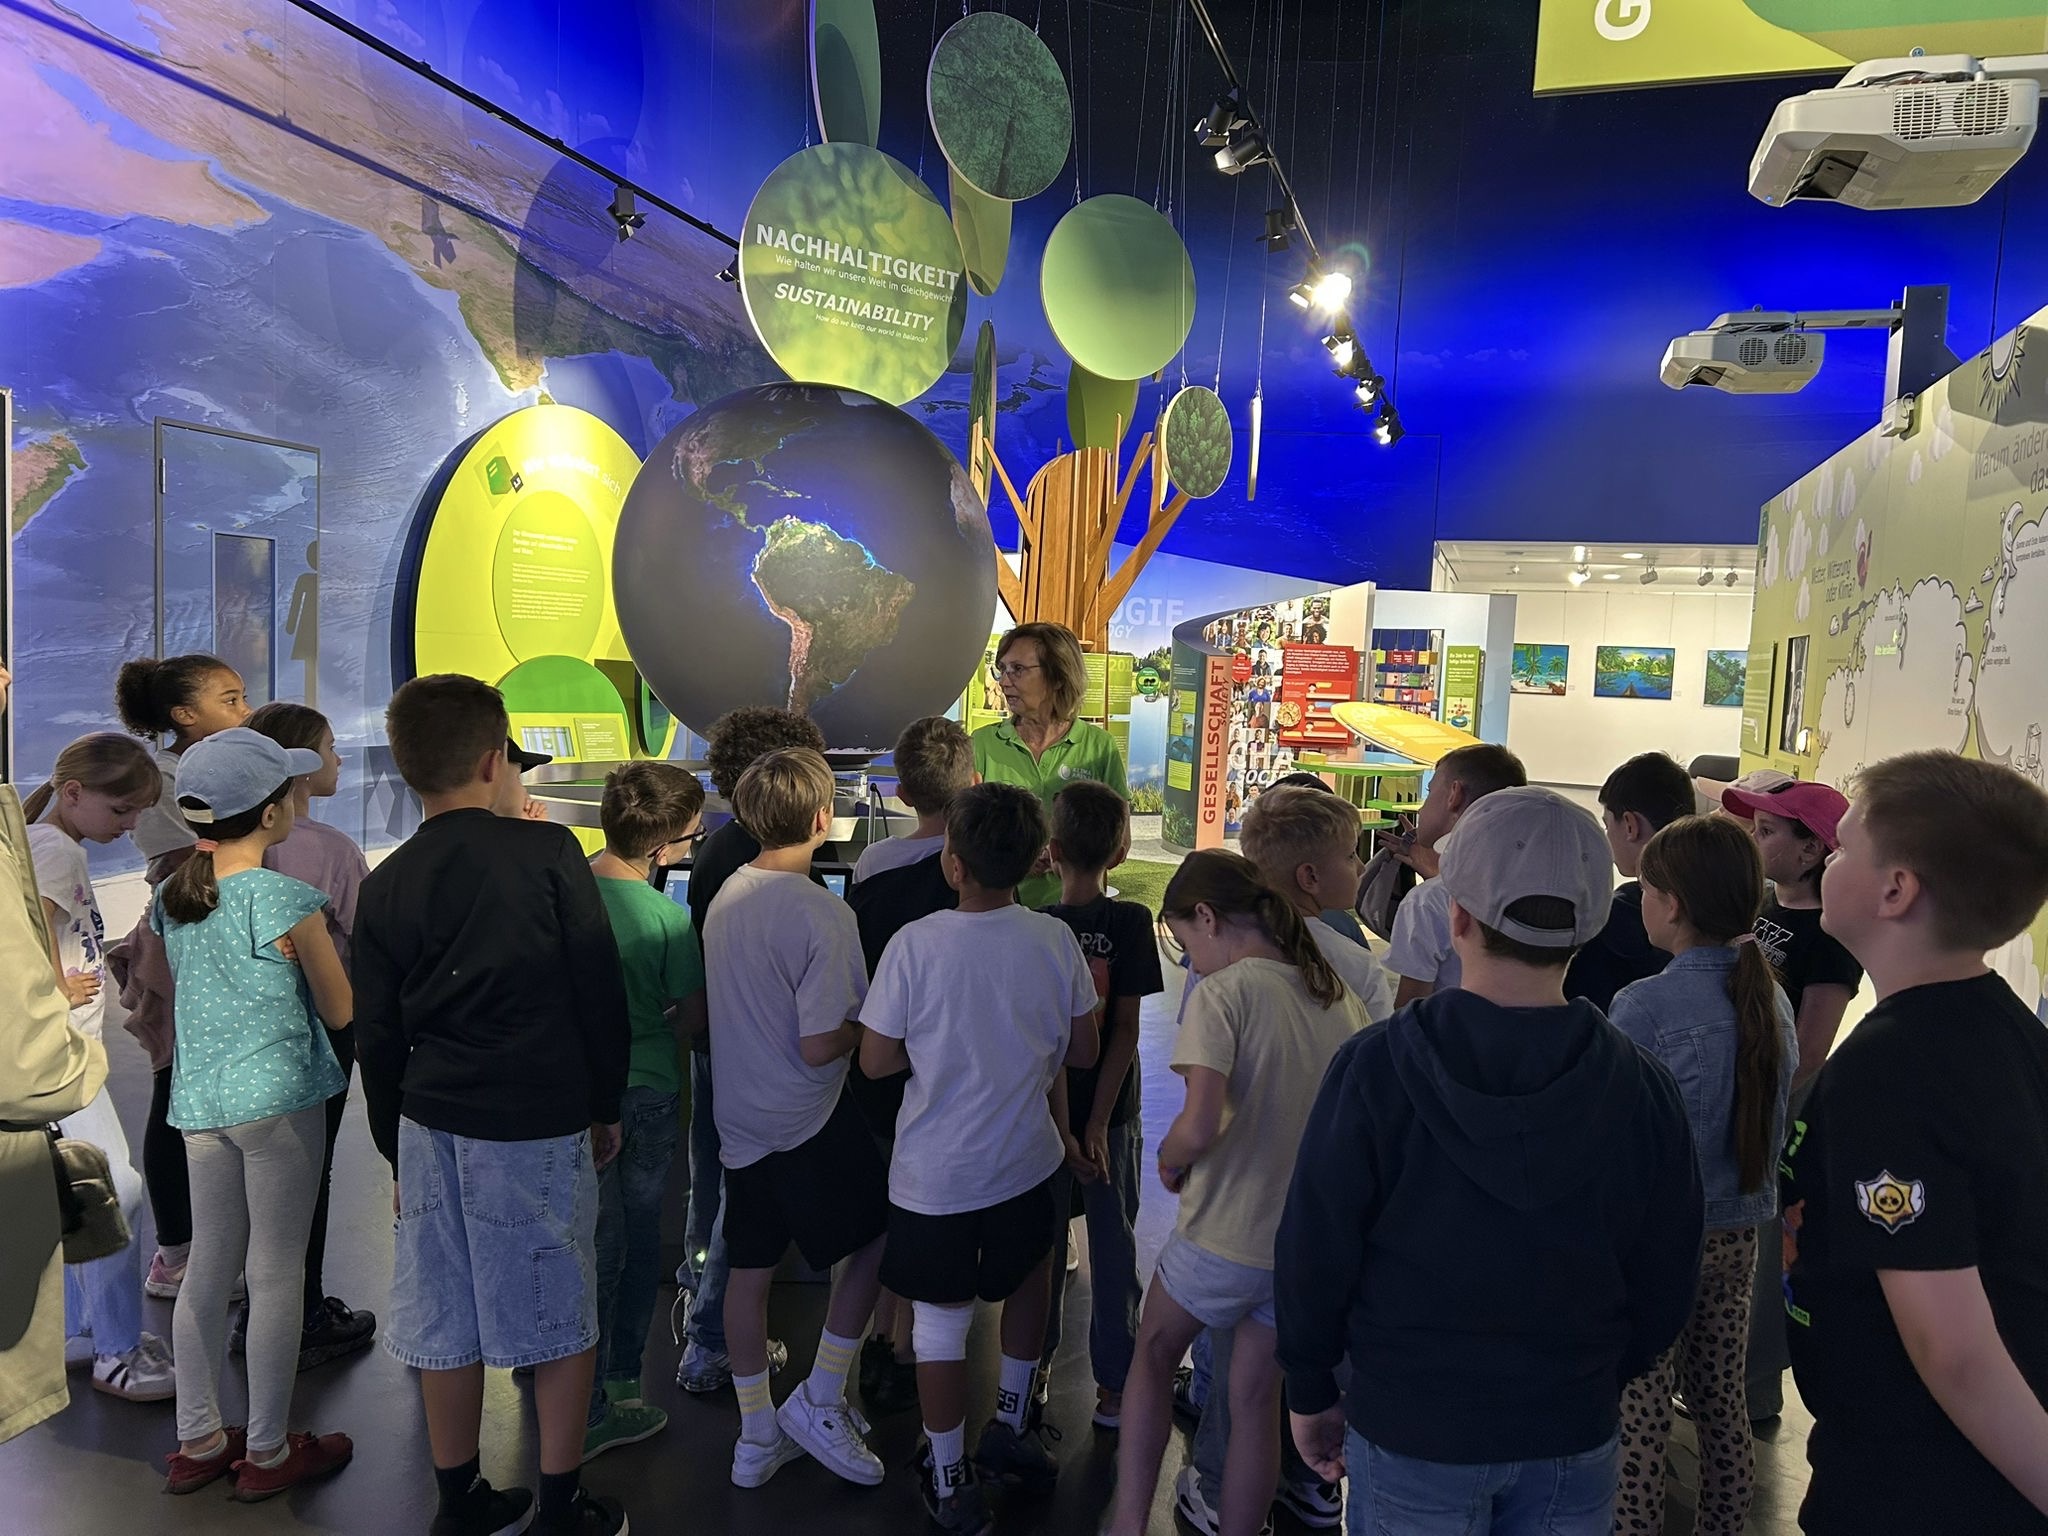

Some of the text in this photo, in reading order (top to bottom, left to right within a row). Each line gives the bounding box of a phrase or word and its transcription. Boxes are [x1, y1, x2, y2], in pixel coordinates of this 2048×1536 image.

[756, 223, 959, 290] NACHHALTIGKEIT
[775, 254, 792, 266] Wie
[794, 259, 821, 273] halten
[823, 266, 836, 276] wir
[838, 271, 866, 284] unsere
[868, 276, 887, 288] Welt
[888, 281, 899, 291] im
[774, 282, 934, 332] SUSTAINABILITY
[1974, 426, 2048, 481] Warum änder
[1220, 678, 1230, 726] SOCIETY
[1203, 661, 1225, 824] GESELLSCHAFT
